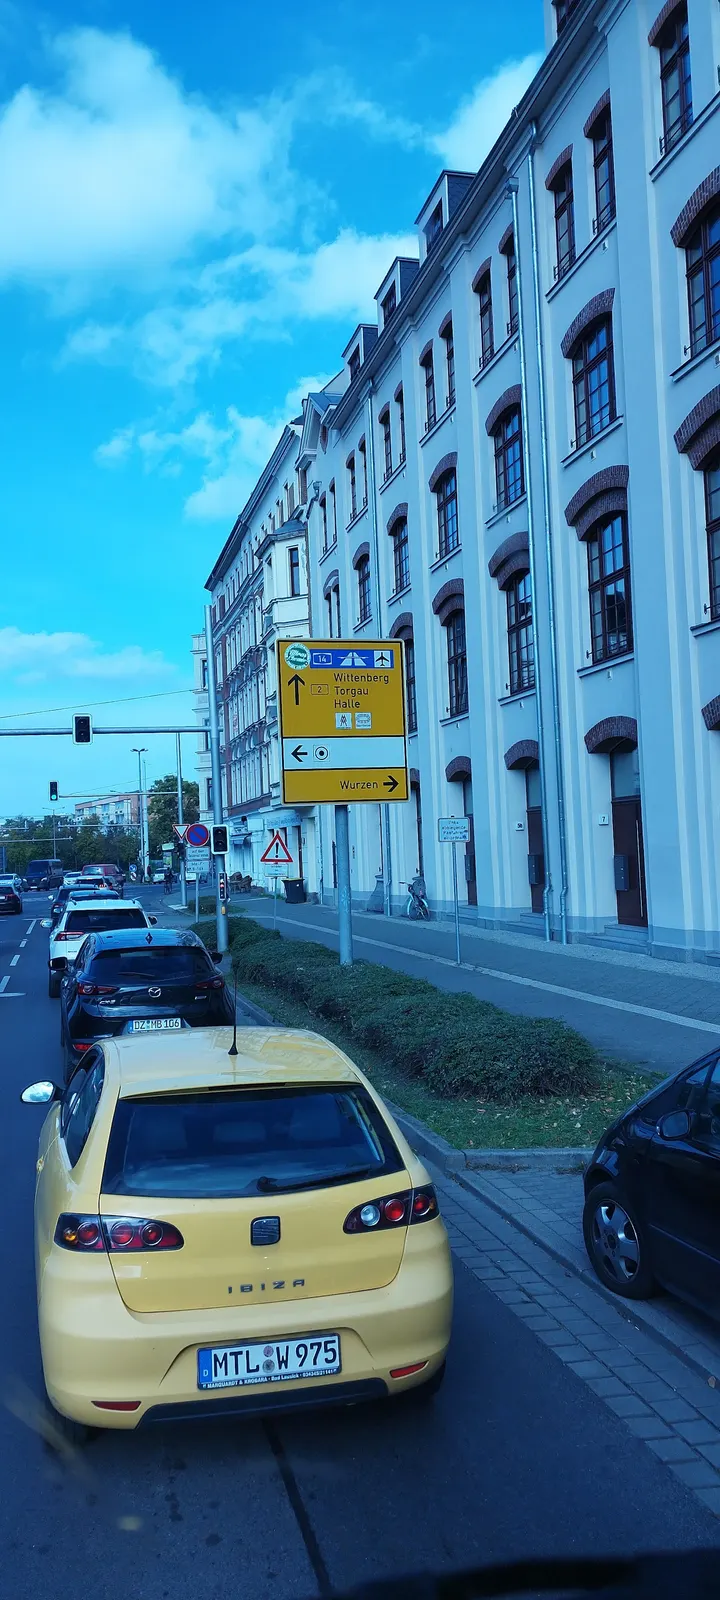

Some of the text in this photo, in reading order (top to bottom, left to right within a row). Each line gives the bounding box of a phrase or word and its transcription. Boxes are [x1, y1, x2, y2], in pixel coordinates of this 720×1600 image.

[317, 655, 328, 663] 14
[333, 672, 390, 685] Wittenberg
[316, 685, 323, 694] 2
[333, 685, 369, 698] Torgau
[333, 699, 361, 709] Halle
[339, 780, 379, 790] Wurzen
[134, 1019, 180, 1030] DZ MB 106
[227, 1279, 305, 1294] IBIZA
[213, 1339, 337, 1378] MTL W 975
[202, 1369, 209, 1377] D
